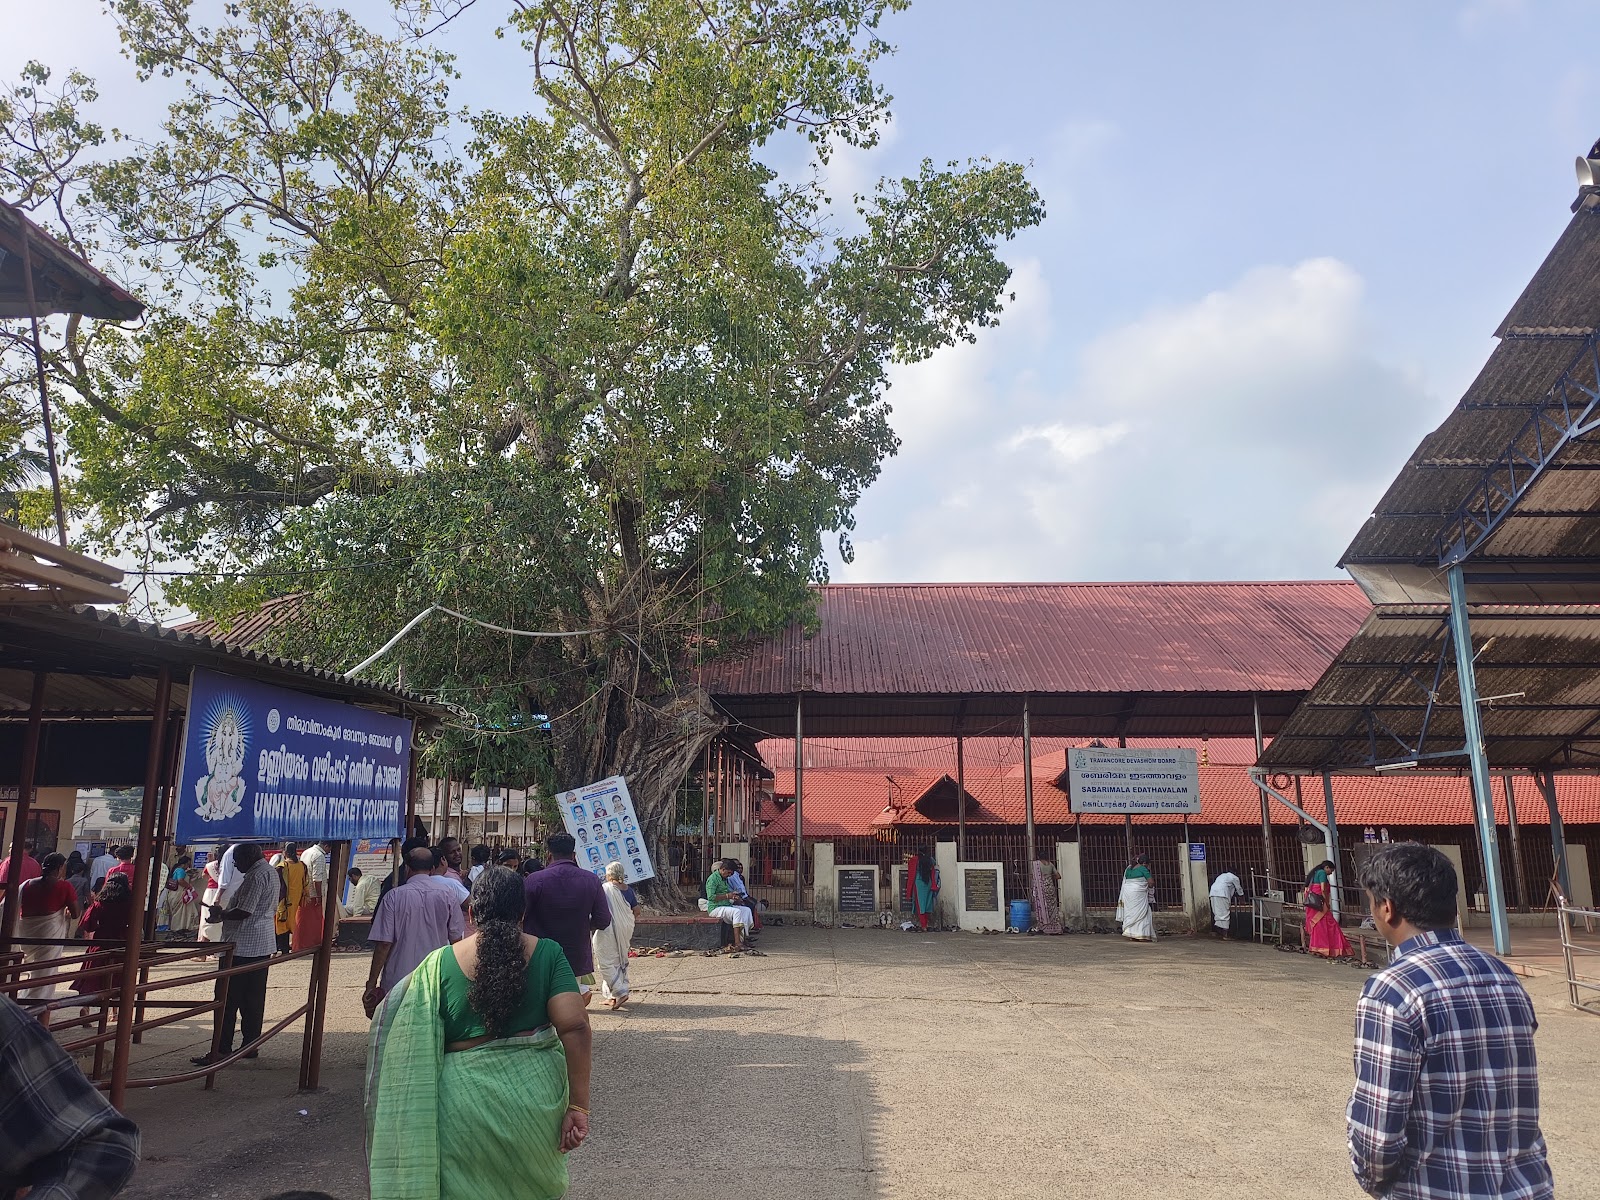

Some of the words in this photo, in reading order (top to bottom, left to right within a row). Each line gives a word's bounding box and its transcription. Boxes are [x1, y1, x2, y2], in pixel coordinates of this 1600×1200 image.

[286, 715, 342, 740] തിരുവിതാംകൂർ
[342, 728, 368, 746] ദേവസ്വം
[368, 733, 393, 749] ബോർഡ്
[257, 744, 309, 786] ഉണ്ണിയപ്പം
[311, 751, 350, 784] വഴിപാട്
[1080, 771, 1127, 779] ശബരിമല
[1129, 773, 1187, 781] ഇടത്താവളം
[253, 792, 327, 820] UNNIYAPPAM
[328, 797, 362, 821] TICKET
[362, 798, 399, 821] COUNTER
